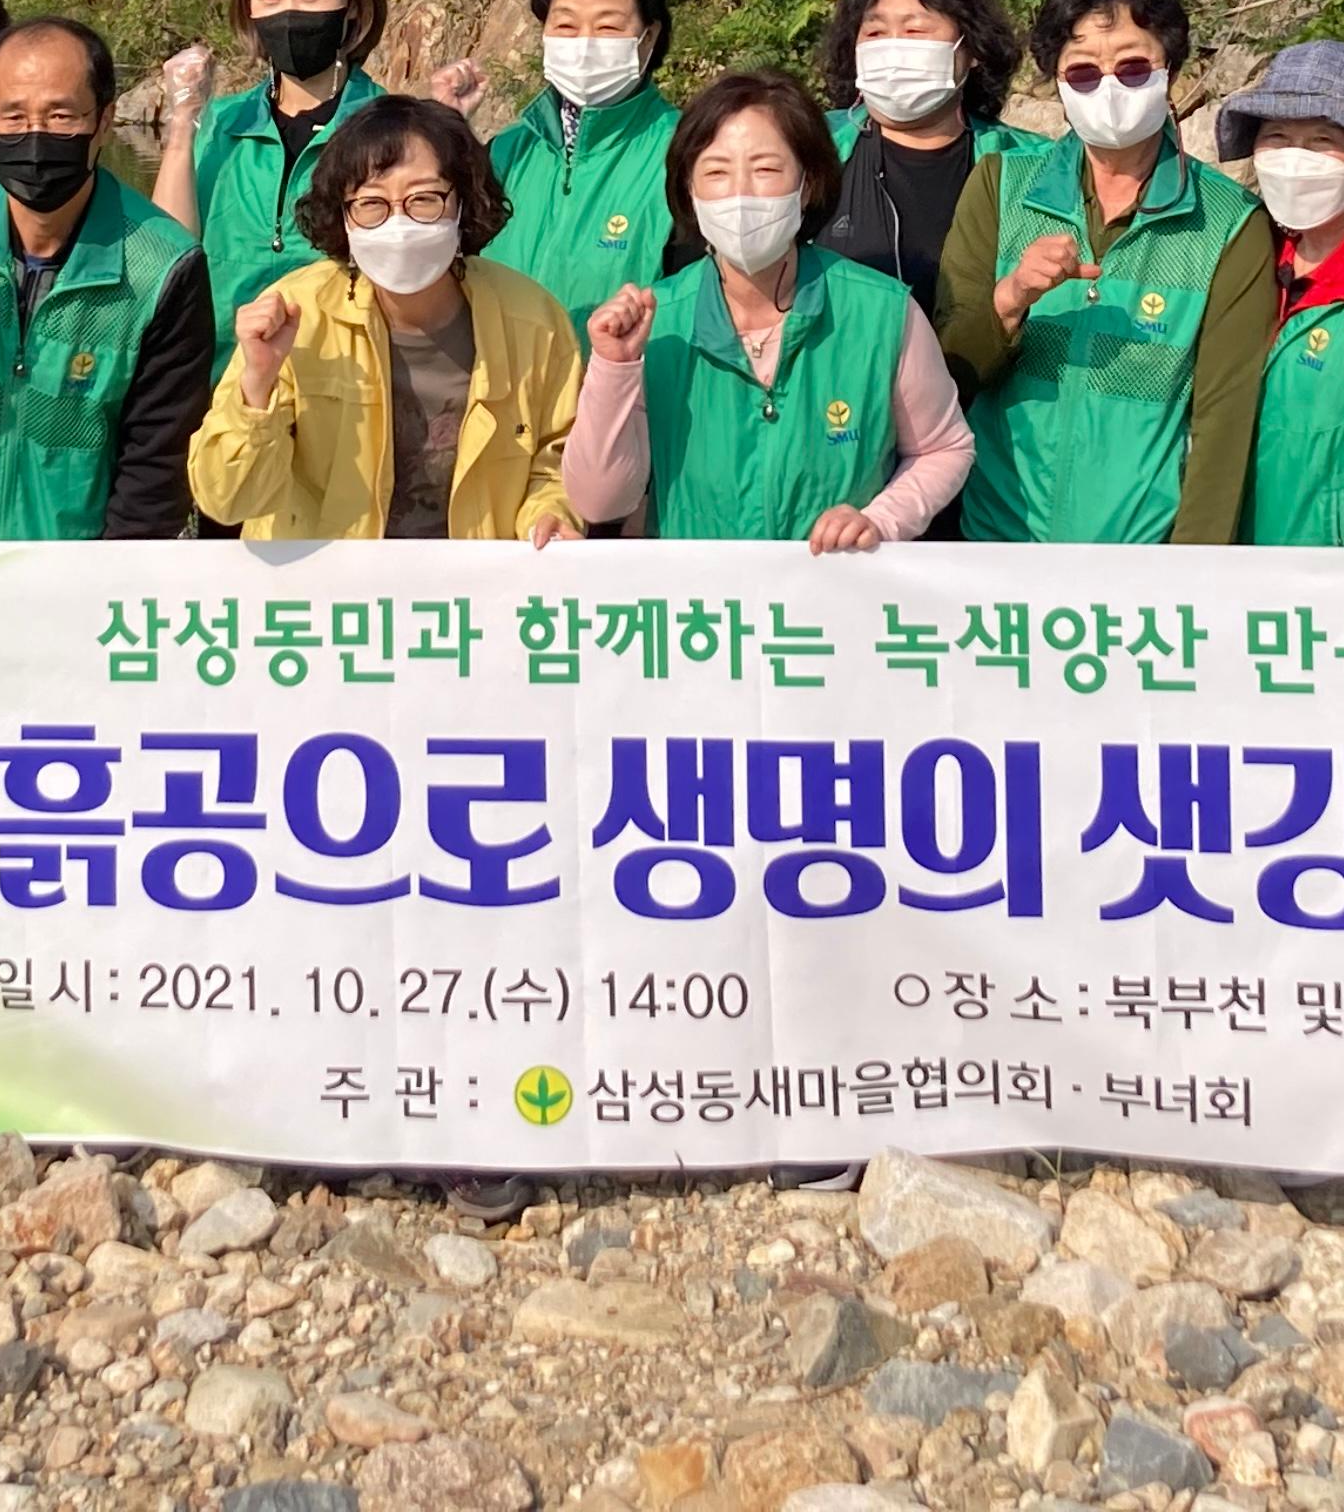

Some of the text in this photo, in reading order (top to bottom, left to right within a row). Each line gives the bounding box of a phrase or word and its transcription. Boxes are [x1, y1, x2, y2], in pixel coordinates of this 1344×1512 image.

[96, 596, 485, 688] 삼성동민과
[514, 594, 837, 688] 함께하는
[873, 601, 1210, 695] 녹색양산
[590, 737, 1045, 922] 생명의
[137, 962, 281, 1018] 2021.
[306, 967, 381, 1019] 10.
[600, 971, 750, 1020] 14:00
[1104, 974, 1268, 1034] 북부천
[1296, 981, 1344, 1037] 및
